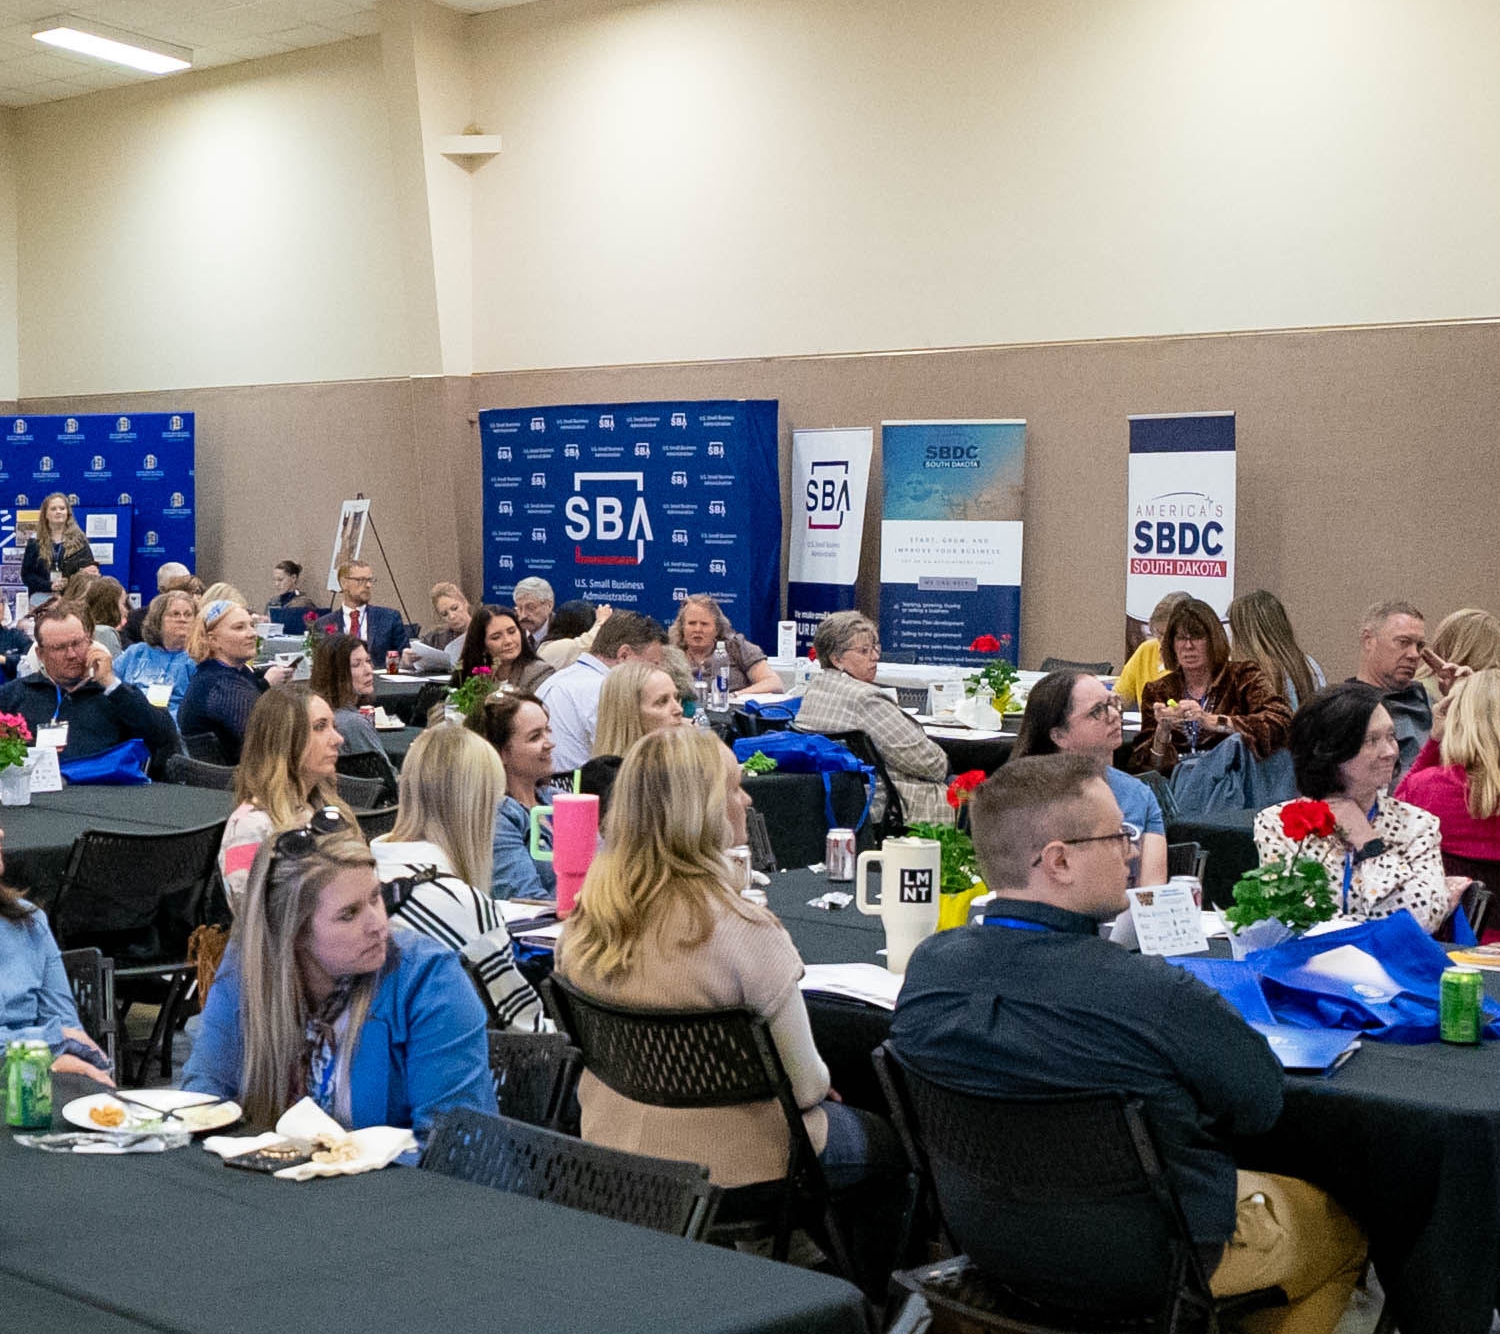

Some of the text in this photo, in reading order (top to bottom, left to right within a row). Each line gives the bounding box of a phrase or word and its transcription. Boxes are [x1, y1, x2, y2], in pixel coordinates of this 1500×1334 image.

[926, 445, 978, 460] SBDC
[806, 479, 851, 511] SBA
[1136, 504, 1223, 517] AMERICA'S
[565, 495, 654, 541] SBA
[1133, 520, 1224, 556] SBDC
[1133, 559, 1221, 576] SOUTH DAKOTA
[574, 579, 645, 590] U.S. Small Business
[583, 591, 638, 602] Administration
[904, 871, 929, 885] LM
[903, 887, 929, 901] NT
